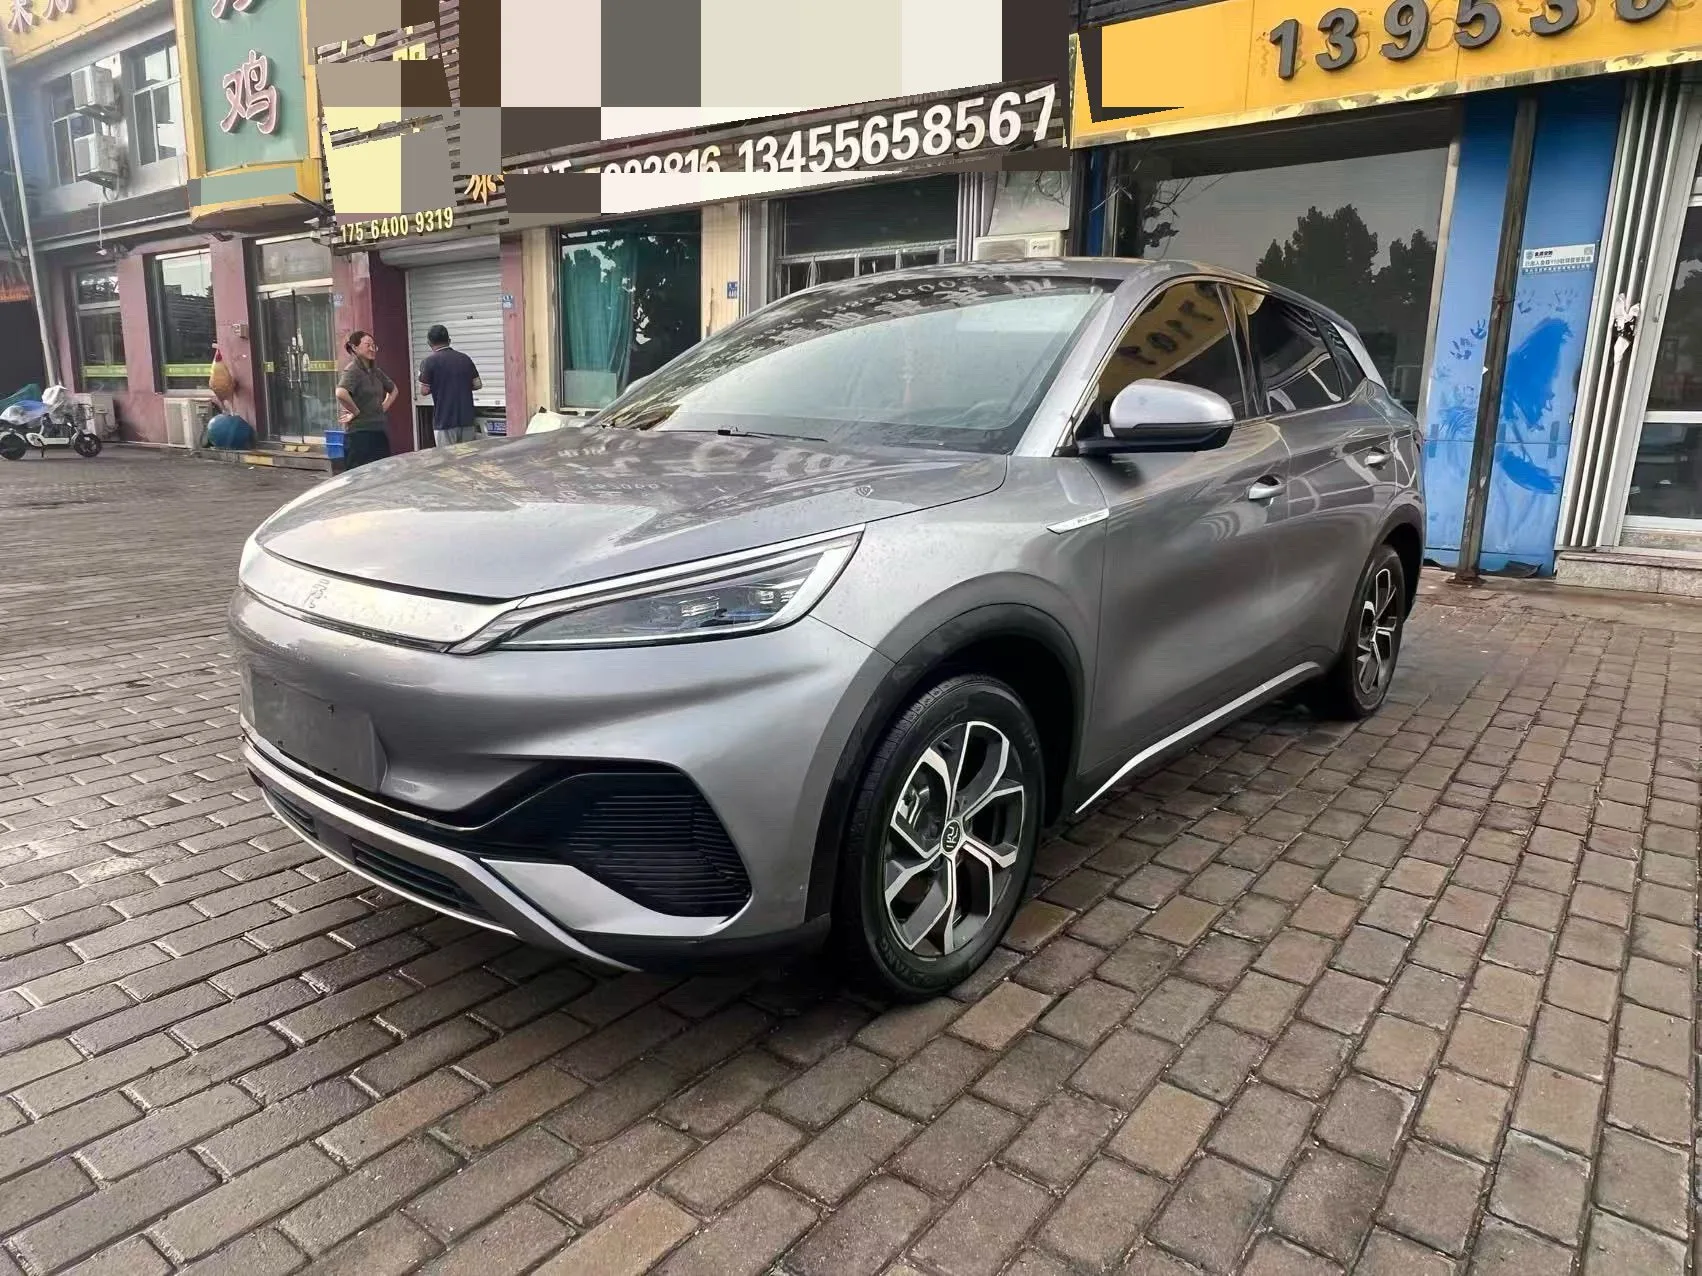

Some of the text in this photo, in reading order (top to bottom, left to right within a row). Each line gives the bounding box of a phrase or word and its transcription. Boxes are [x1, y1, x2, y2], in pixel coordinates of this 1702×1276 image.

[738, 83, 1057, 172] 13455658567
[340, 206, 454, 243] 175 6400 9319
